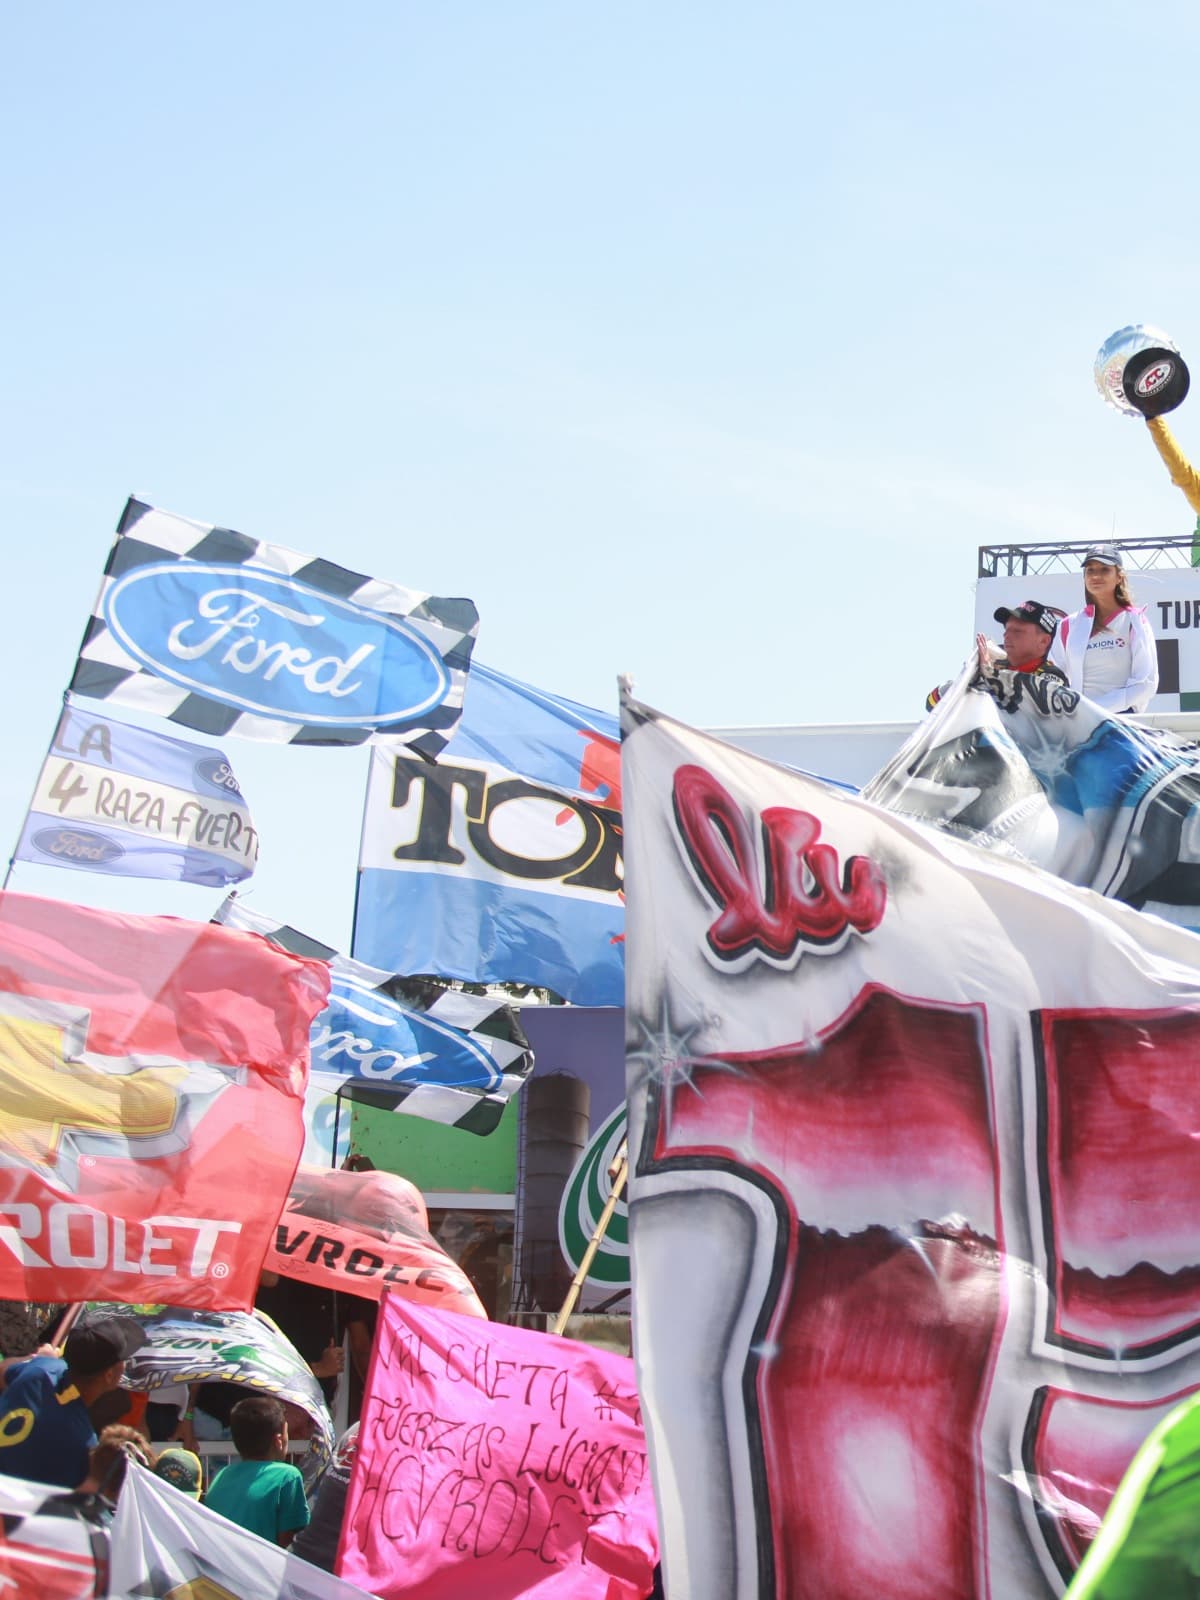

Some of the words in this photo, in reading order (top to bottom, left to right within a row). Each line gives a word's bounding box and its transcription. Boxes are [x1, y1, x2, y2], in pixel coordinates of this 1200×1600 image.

[168, 588, 375, 699] Ford
[1086, 640, 1114, 651] AXION
[54, 710, 113, 764] LA
[94, 777, 165, 833] RAZA
[51, 831, 106, 862] Ford
[0, 1202, 242, 1278] ROLET
